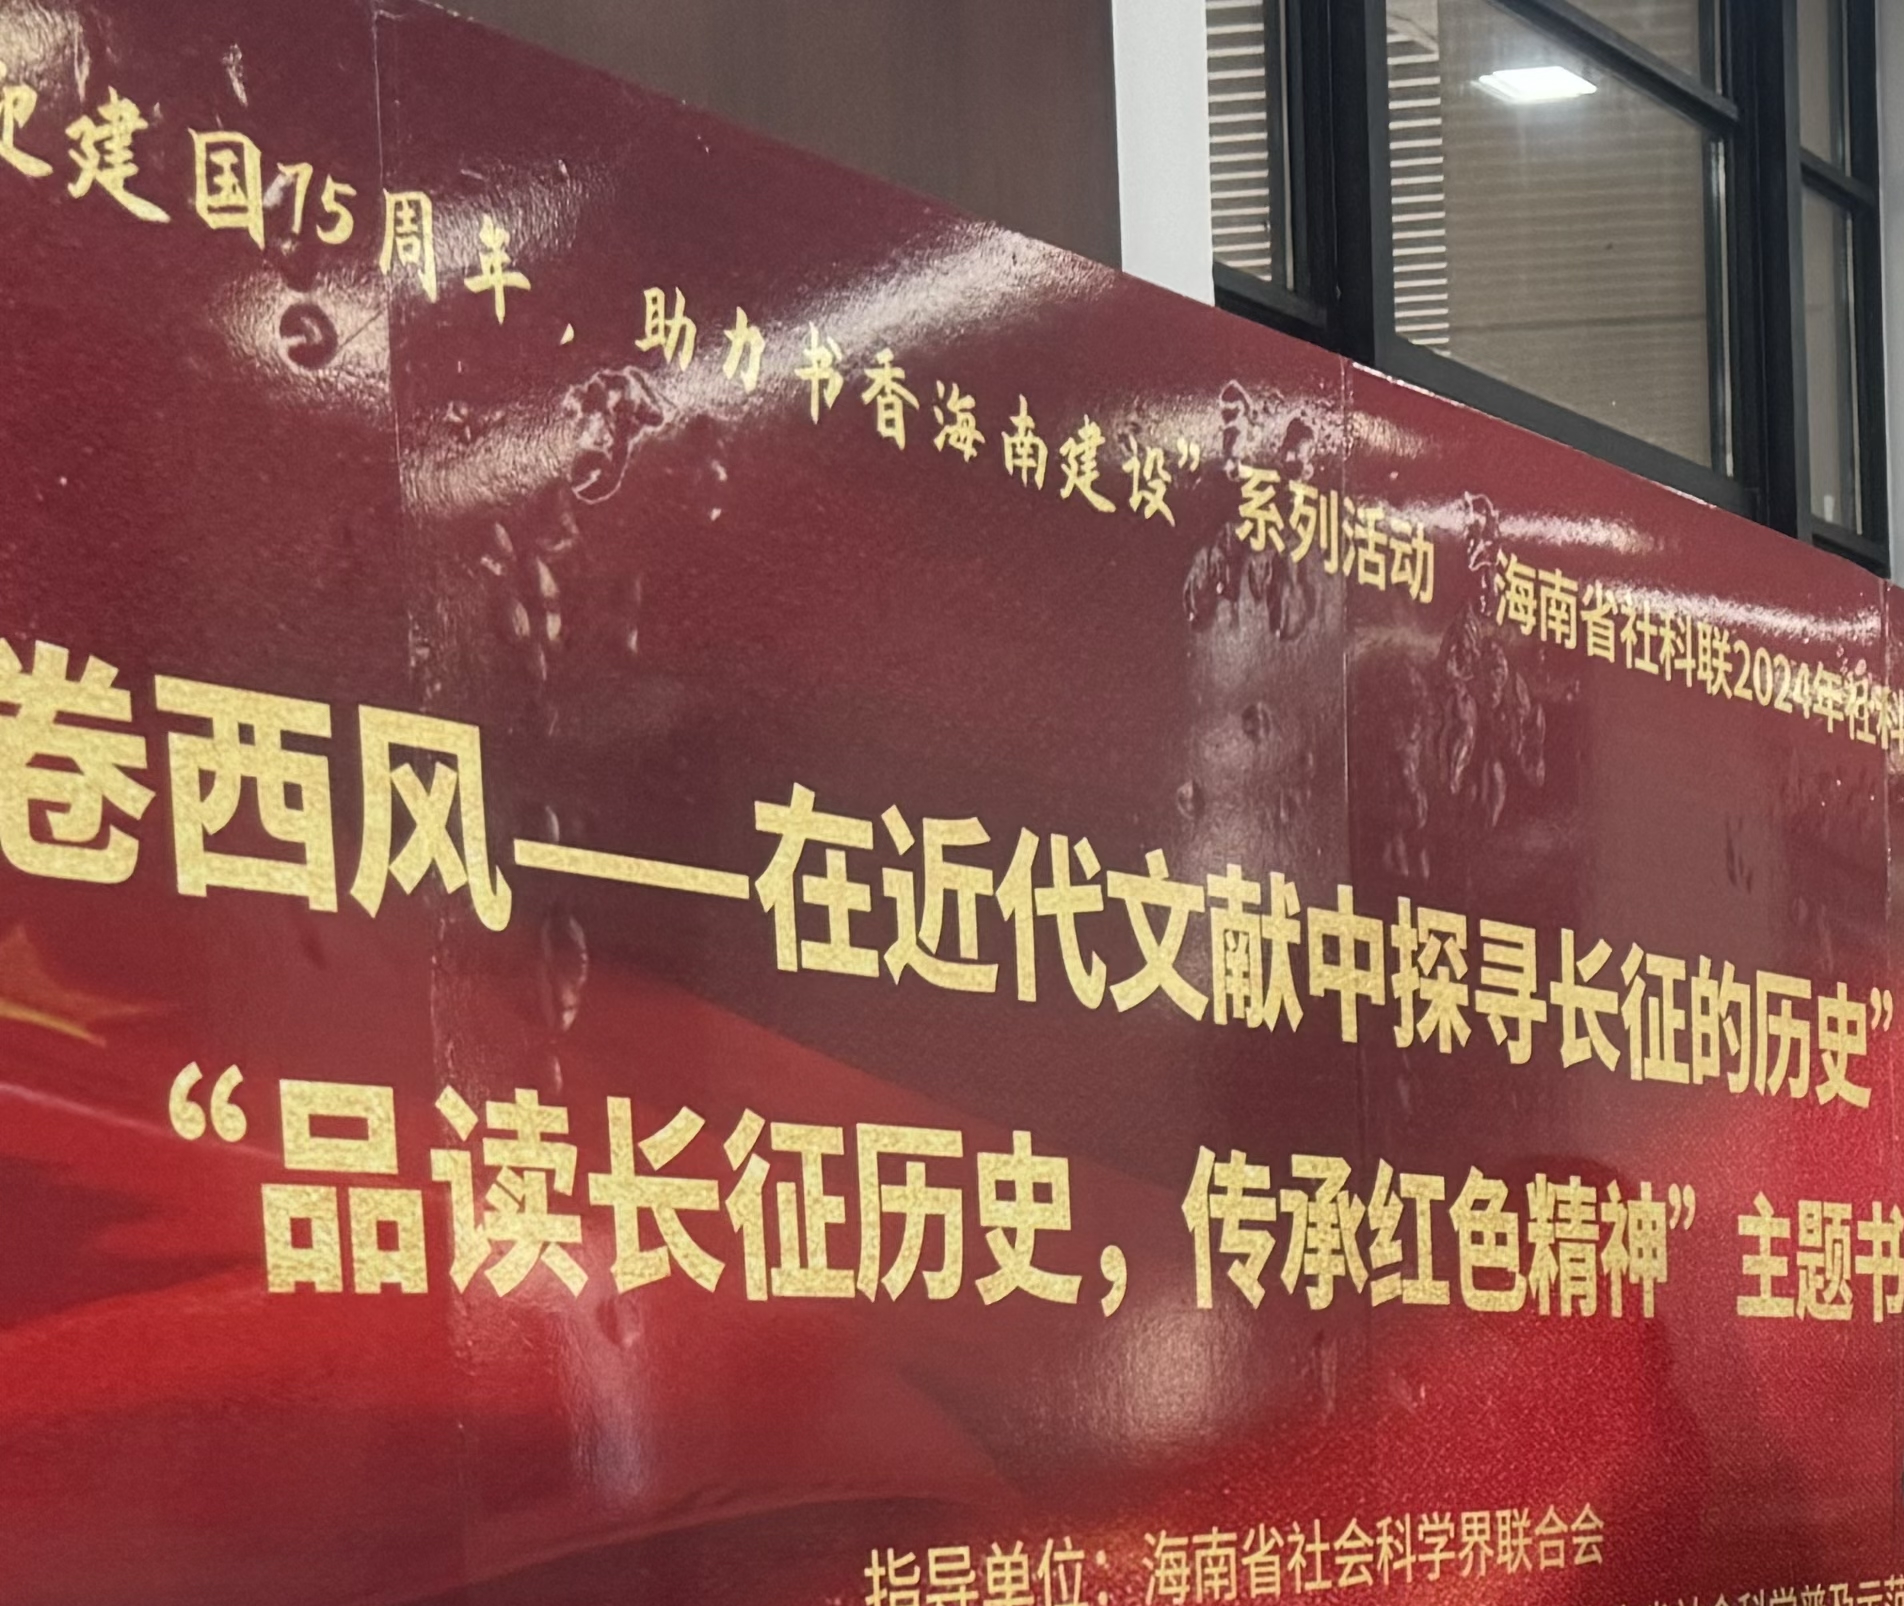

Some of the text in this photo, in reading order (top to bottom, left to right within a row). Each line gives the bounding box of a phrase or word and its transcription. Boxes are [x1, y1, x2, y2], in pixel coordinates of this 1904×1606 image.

[1236, 465, 1435, 604] 系列活动
[168, 1062, 1696, 1320] “品读长征历史，传承红色精神”
